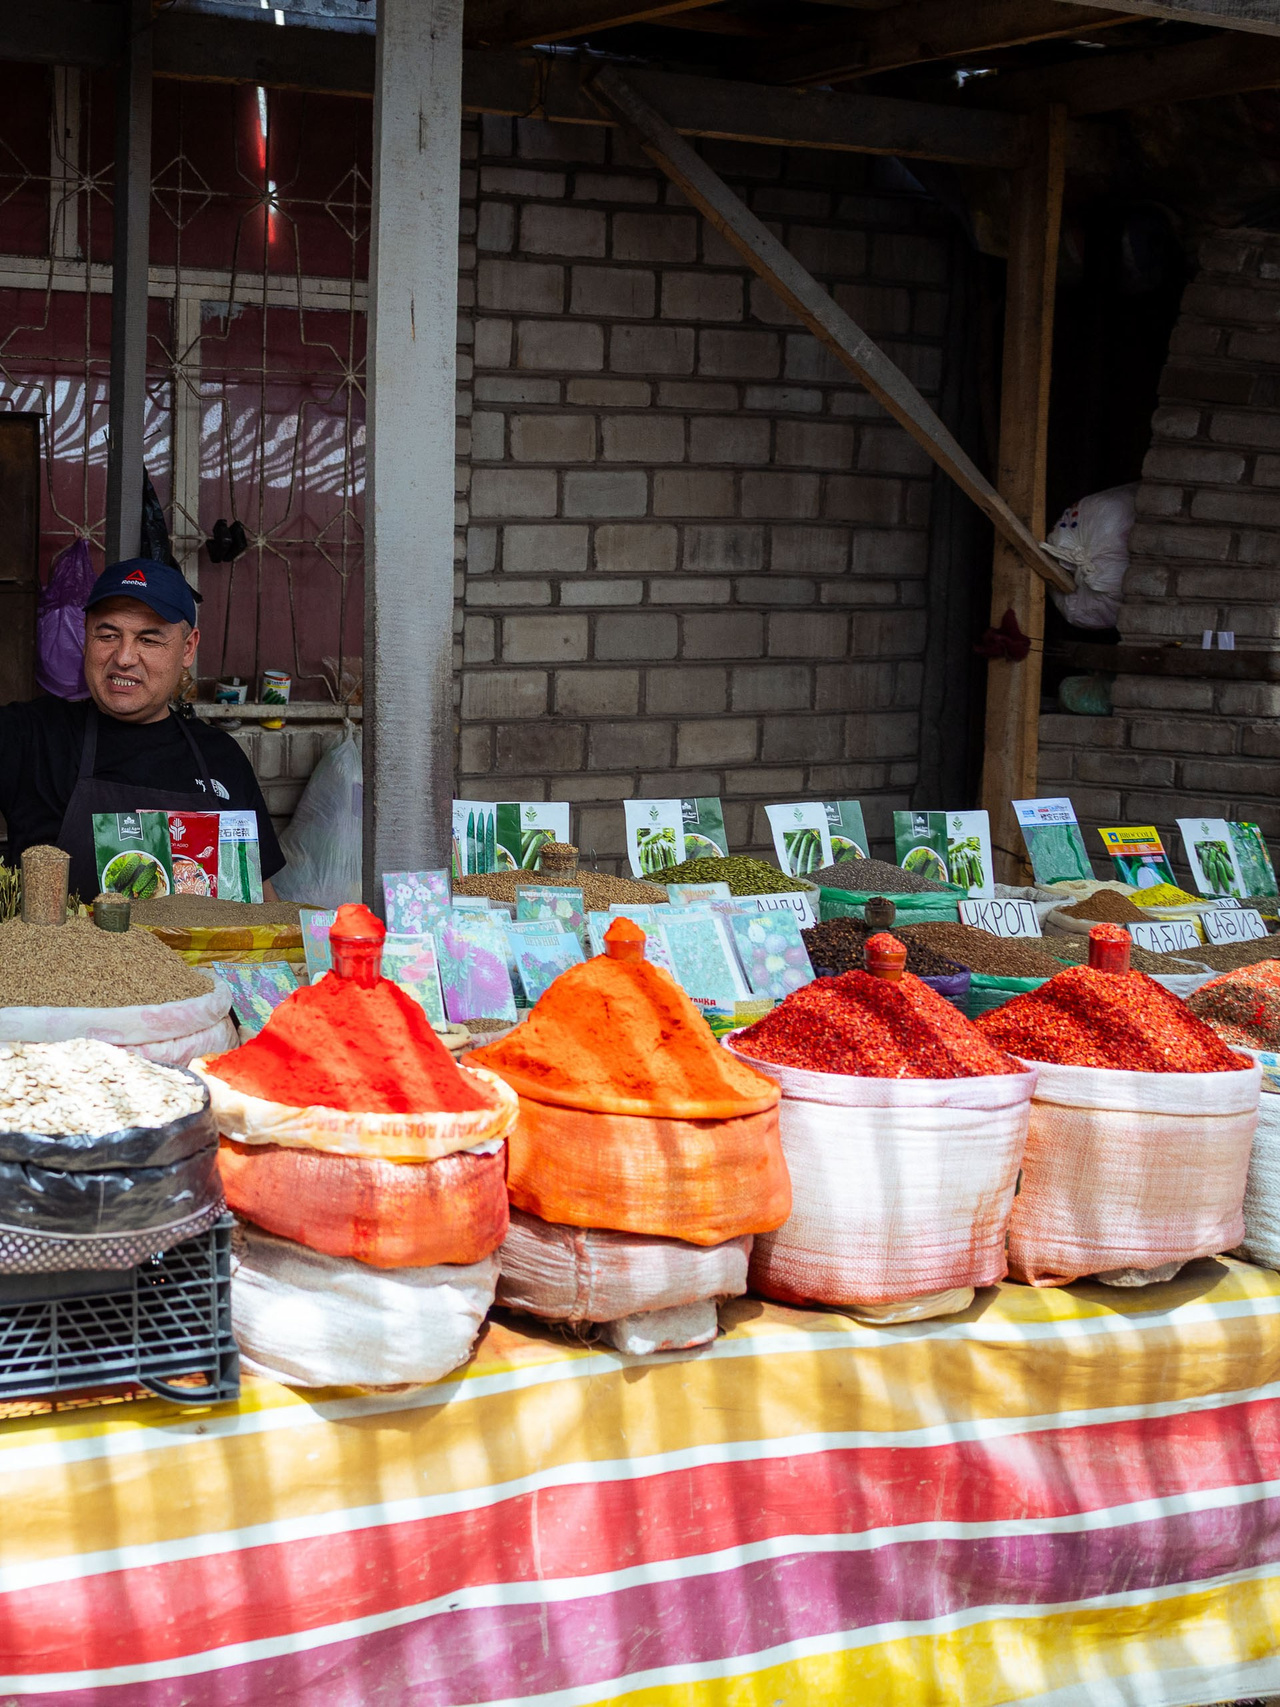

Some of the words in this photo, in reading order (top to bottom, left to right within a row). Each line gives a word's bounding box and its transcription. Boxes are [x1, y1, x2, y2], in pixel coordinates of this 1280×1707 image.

[121, 580, 148, 588] Reebok
[1119, 831, 1154, 839] BROCCOLI
[964, 901, 1038, 936] УКРОП
